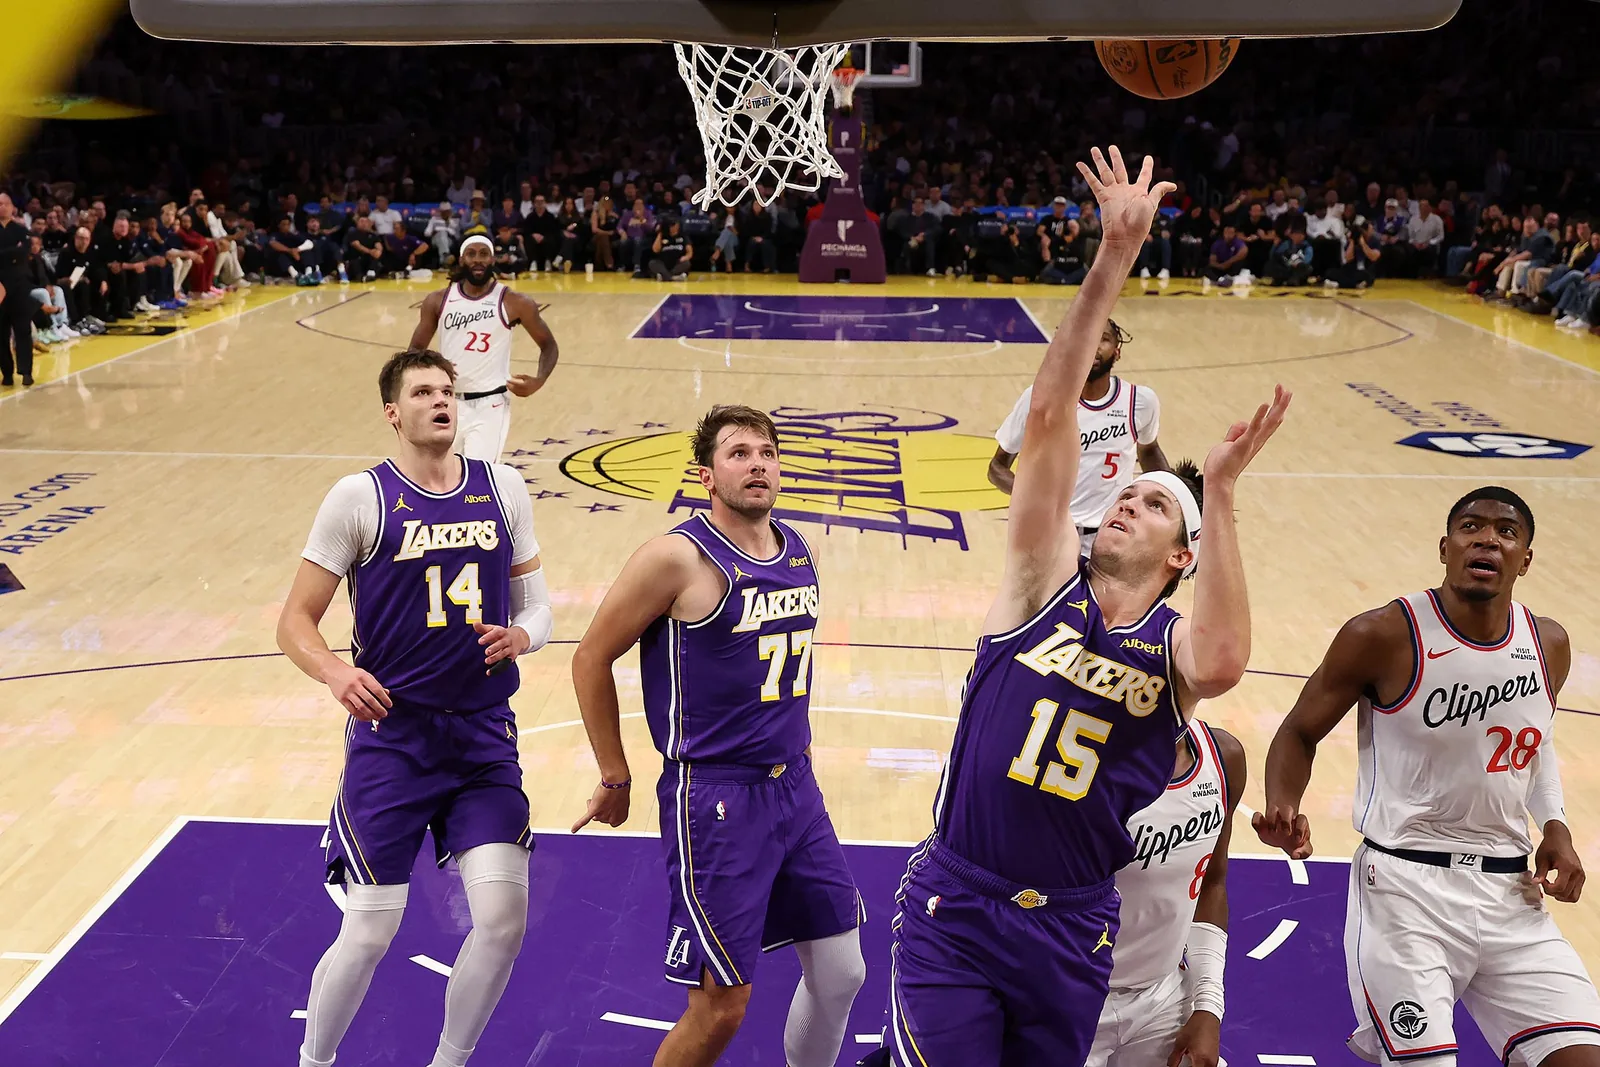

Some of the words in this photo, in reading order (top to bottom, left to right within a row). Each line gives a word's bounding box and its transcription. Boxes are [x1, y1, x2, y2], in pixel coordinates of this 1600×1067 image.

[752, 98, 771, 109] TIP-OFF
[821, 243, 867, 252] PECHANGA
[444, 309, 496, 330] Clippers
[464, 331, 492, 353] 23
[1101, 452, 1121, 479] 5
[464, 494, 492, 505] Albert
[0, 506, 107, 554] ARENA
[393, 519, 500, 562] LAKERS
[788, 556, 809, 568] Albert
[425, 562, 483, 628] 14
[731, 584, 820, 634] LAKERS
[1119, 638, 1164, 656] Albert
[1510, 653, 1537, 661] RWANDA
[758, 629, 814, 703] 77
[1014, 621, 1166, 718] LAKERS
[1422, 671, 1541, 729] Clippers
[1007, 697, 1113, 802] 15
[1486, 725, 1543, 774] 28
[1192, 789, 1219, 798] RWANDA
[1197, 782, 1213, 790] VISIT
[1130, 803, 1224, 870] lippers
[664, 925, 691, 968] LA
